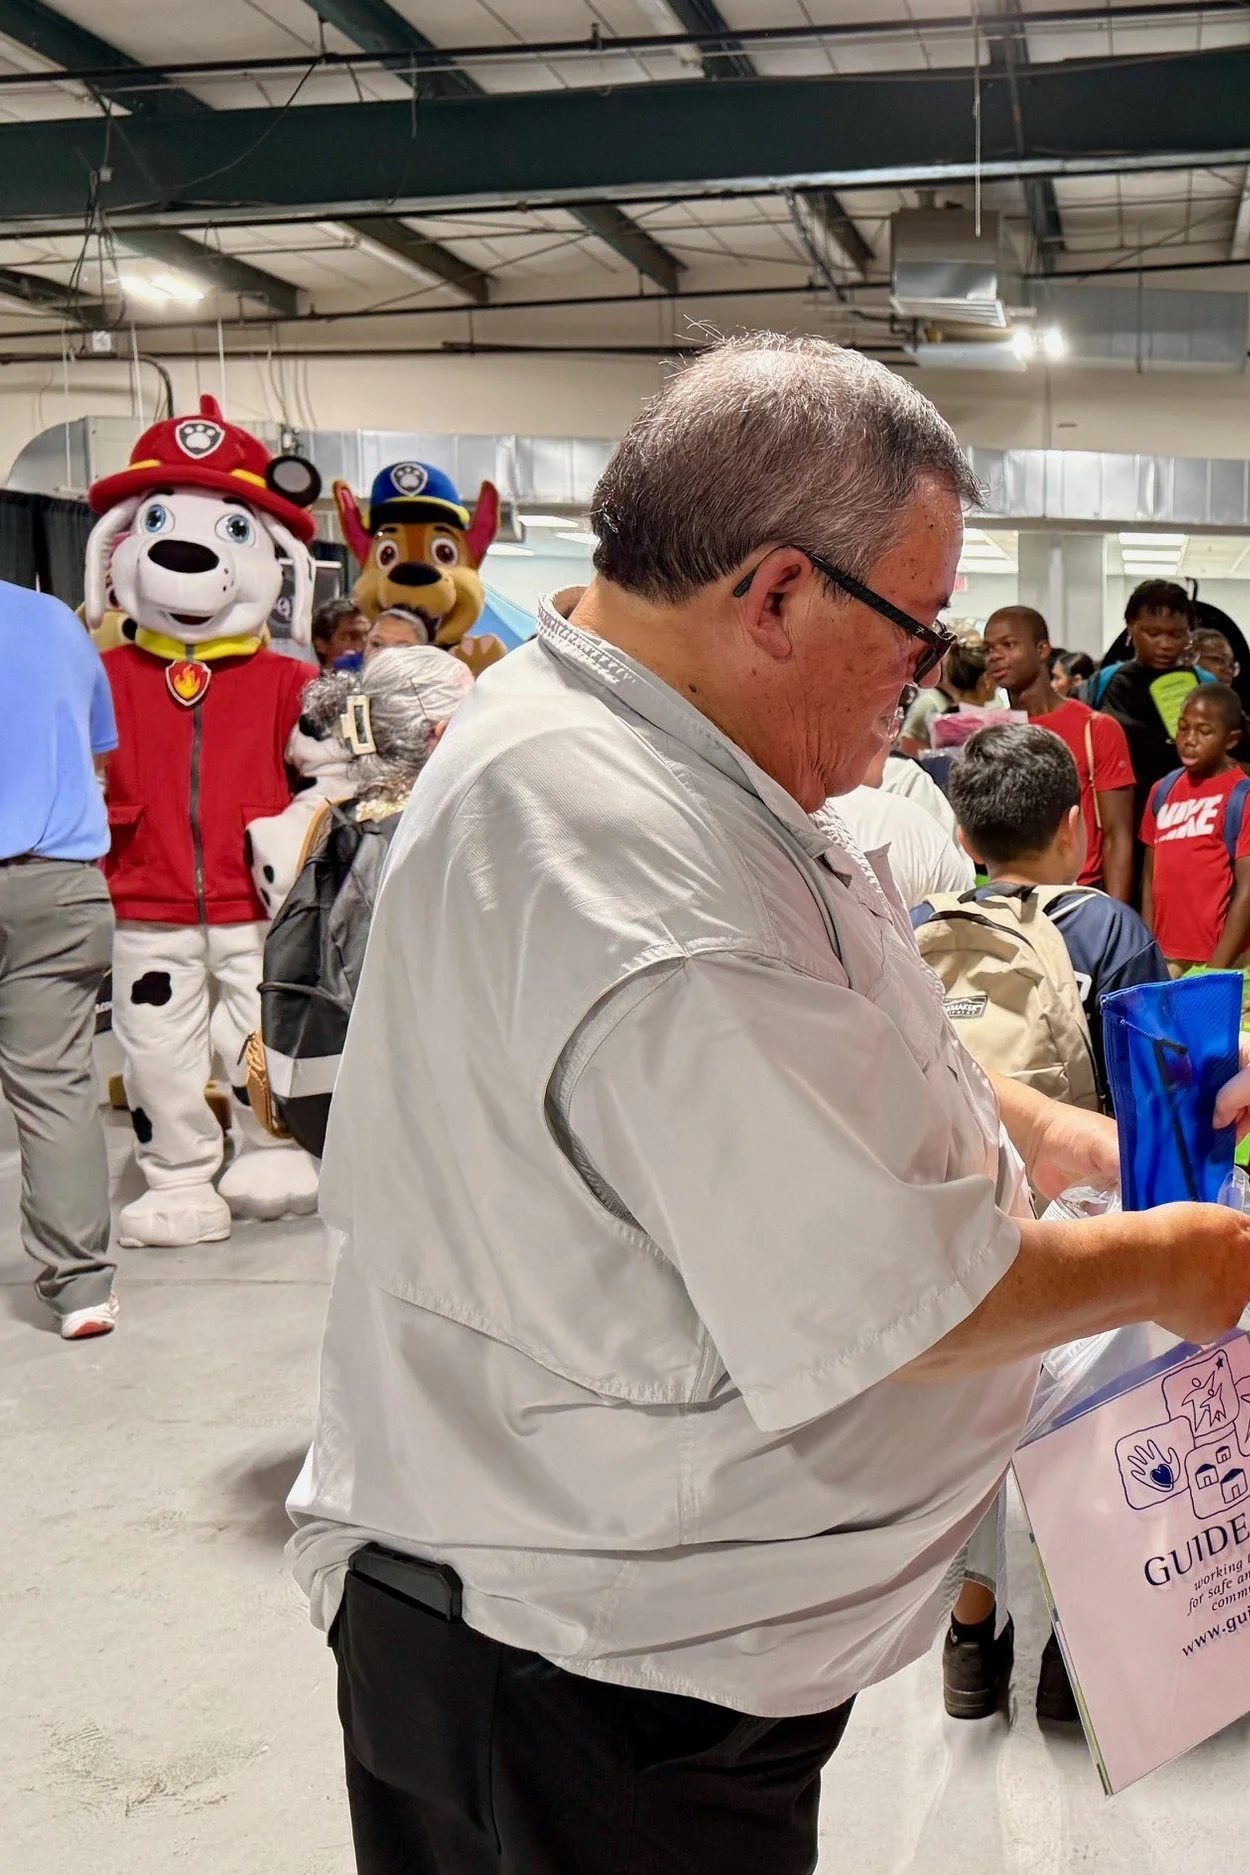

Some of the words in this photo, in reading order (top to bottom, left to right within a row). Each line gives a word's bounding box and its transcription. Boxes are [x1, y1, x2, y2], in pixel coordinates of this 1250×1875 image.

[1154, 794, 1224, 843] NIKE
[1194, 1558, 1243, 1591] working
[1187, 1597, 1204, 1616] for
[1208, 1578, 1233, 1601] safe
